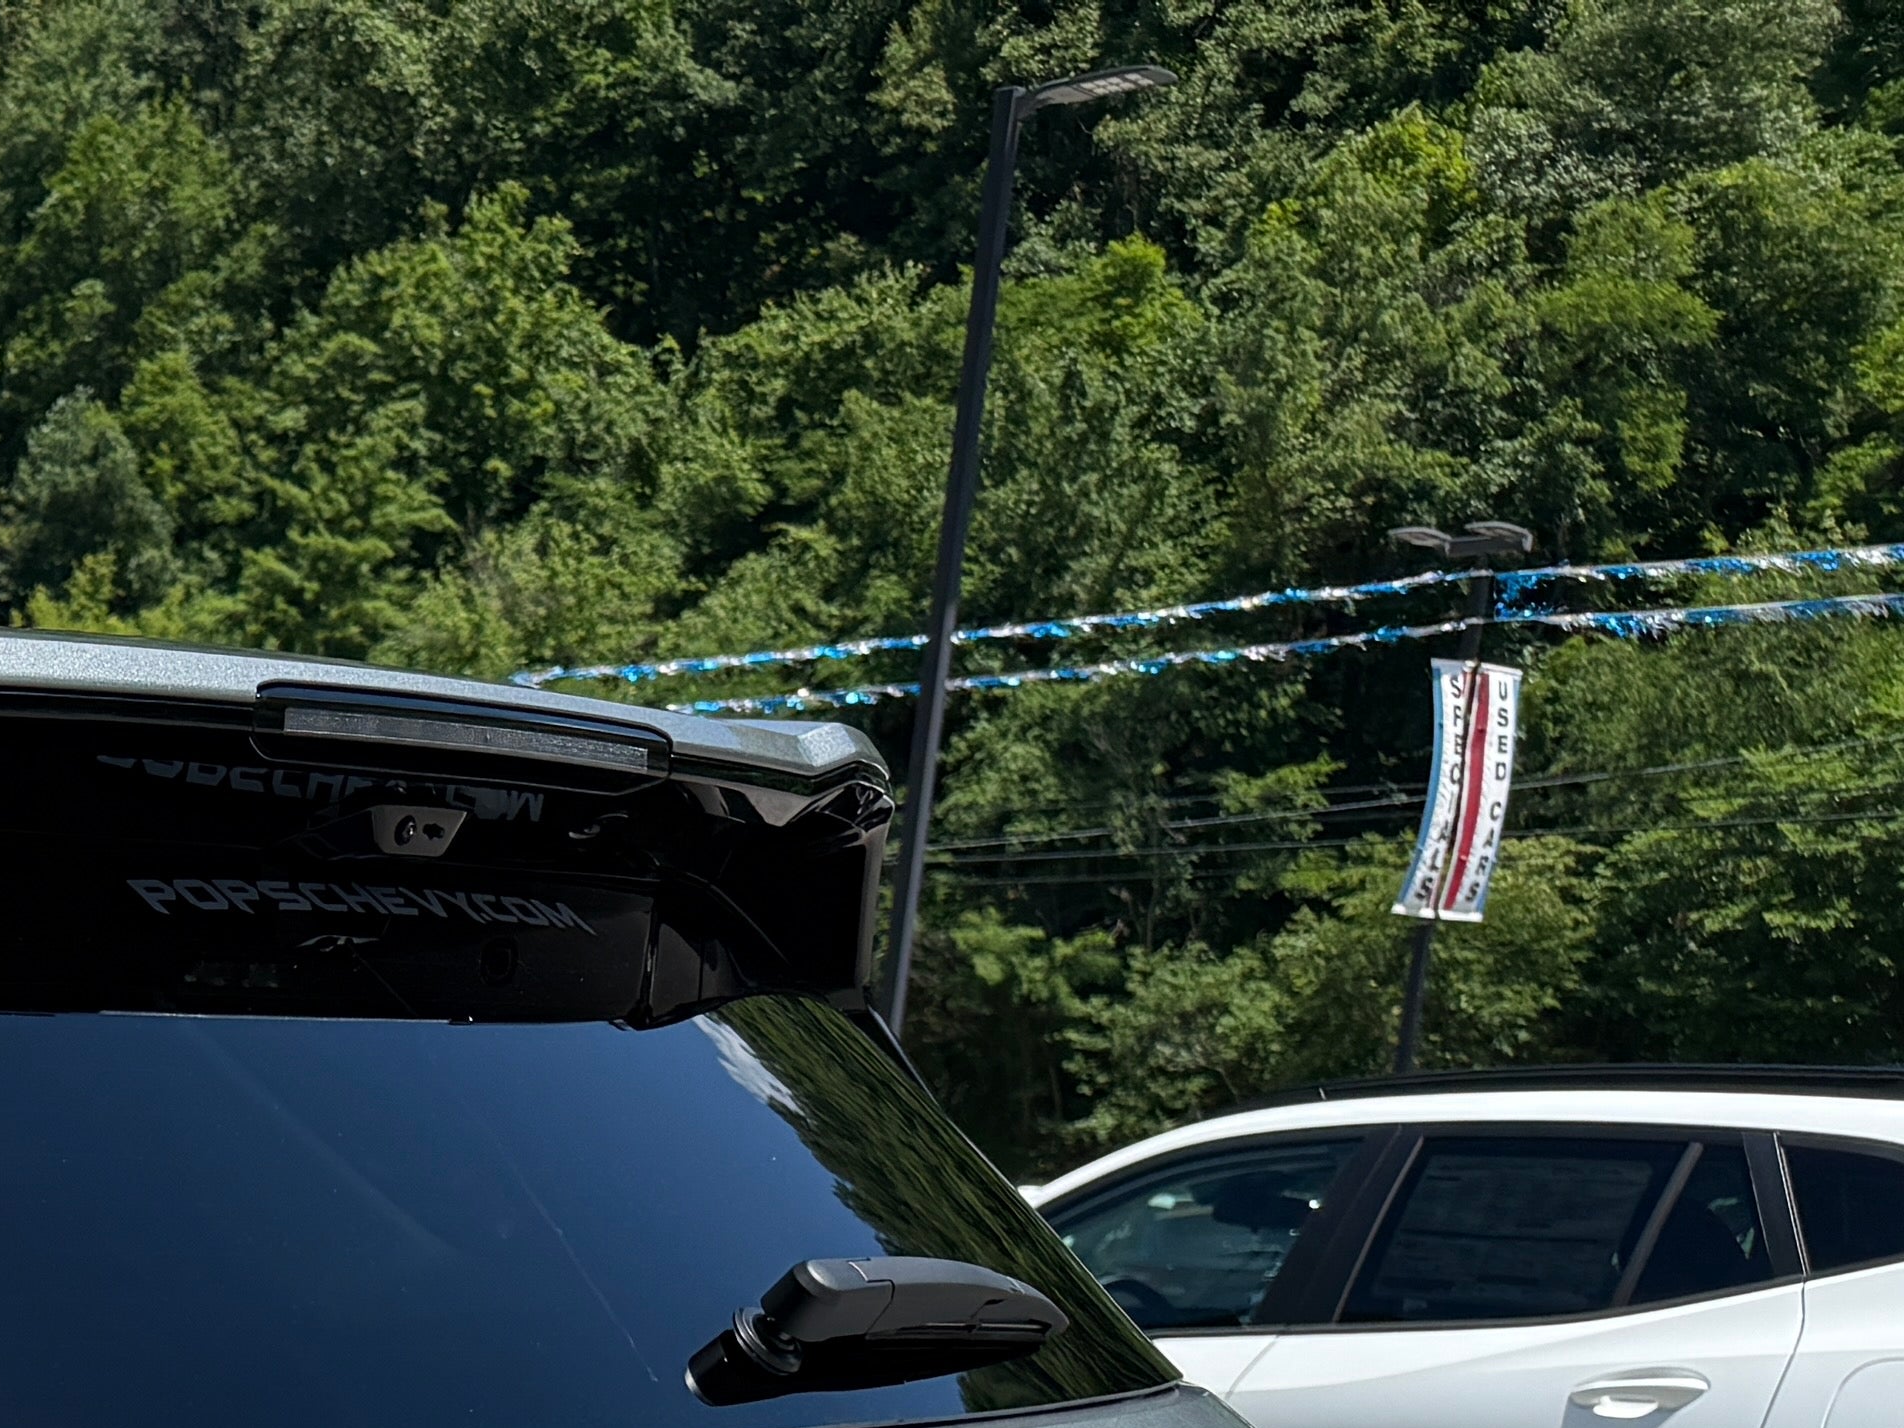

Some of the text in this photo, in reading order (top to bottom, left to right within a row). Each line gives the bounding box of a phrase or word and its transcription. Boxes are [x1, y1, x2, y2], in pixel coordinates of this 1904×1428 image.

[1464, 680, 1510, 903] USED CARS
[126, 879, 598, 937] POPSCHEVY.COM
